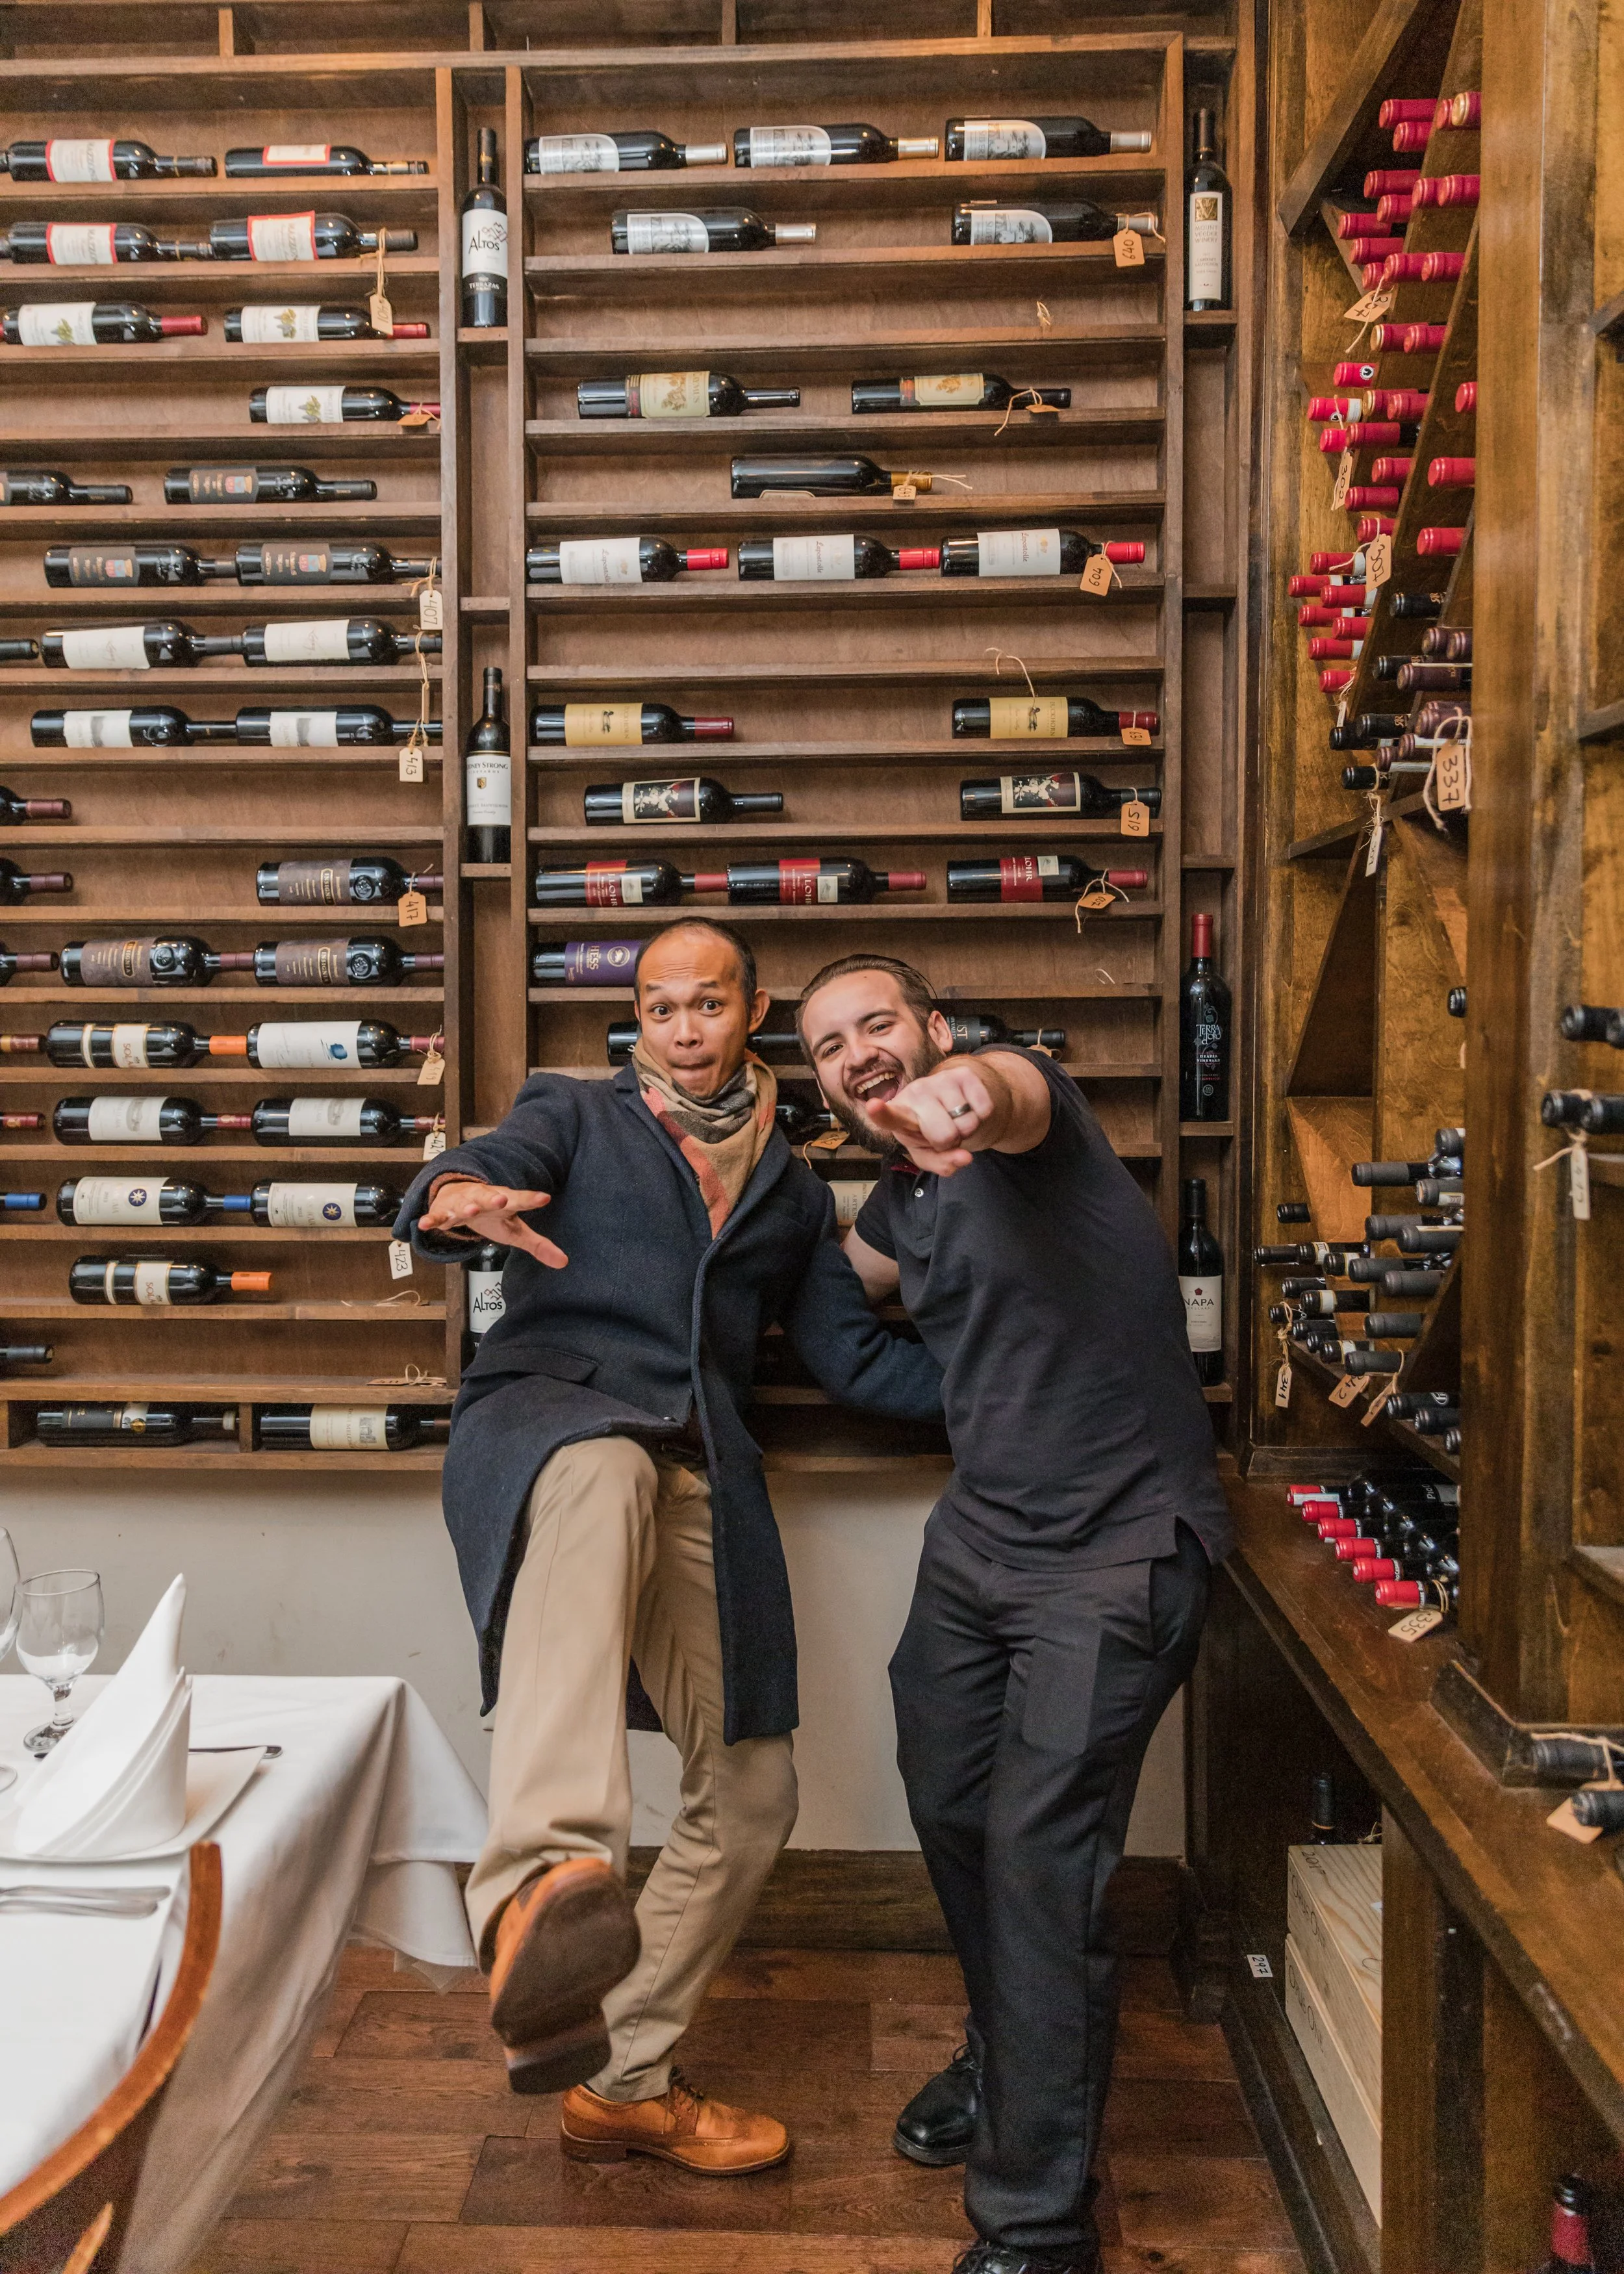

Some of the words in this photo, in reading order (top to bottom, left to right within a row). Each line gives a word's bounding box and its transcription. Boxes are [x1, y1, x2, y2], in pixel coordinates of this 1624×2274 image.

[1122, 239, 1136, 260] 640
[469, 281, 500, 290] TERRAZAS
[1020, 532, 1028, 562] Lapostolle
[602, 549, 611, 583] Lapostolle
[1370, 544, 1385, 582] 307
[1089, 567, 1104, 587] 604
[424, 606, 438, 625] 407
[406, 757, 418, 775] 413
[482, 761, 509, 770] STRONG
[1441, 755, 1459, 804] 337
[1128, 808, 1141, 832] 615
[1024, 857, 1033, 882] LOHR
[407, 901, 419, 921] 417
[125, 943, 134, 973] INSIGNIA
[590, 945, 600, 970] HESS
[1196, 1024, 1221, 1036] TERRA
[123, 1043, 134, 1066] SOLA
[394, 1249, 409, 1271] 423
[146, 1282, 155, 1304] SOLA
[1278, 1374, 1288, 1399] 341
[1401, 1613, 1433, 1636] 335
[1251, 1956, 1269, 1974] 297
